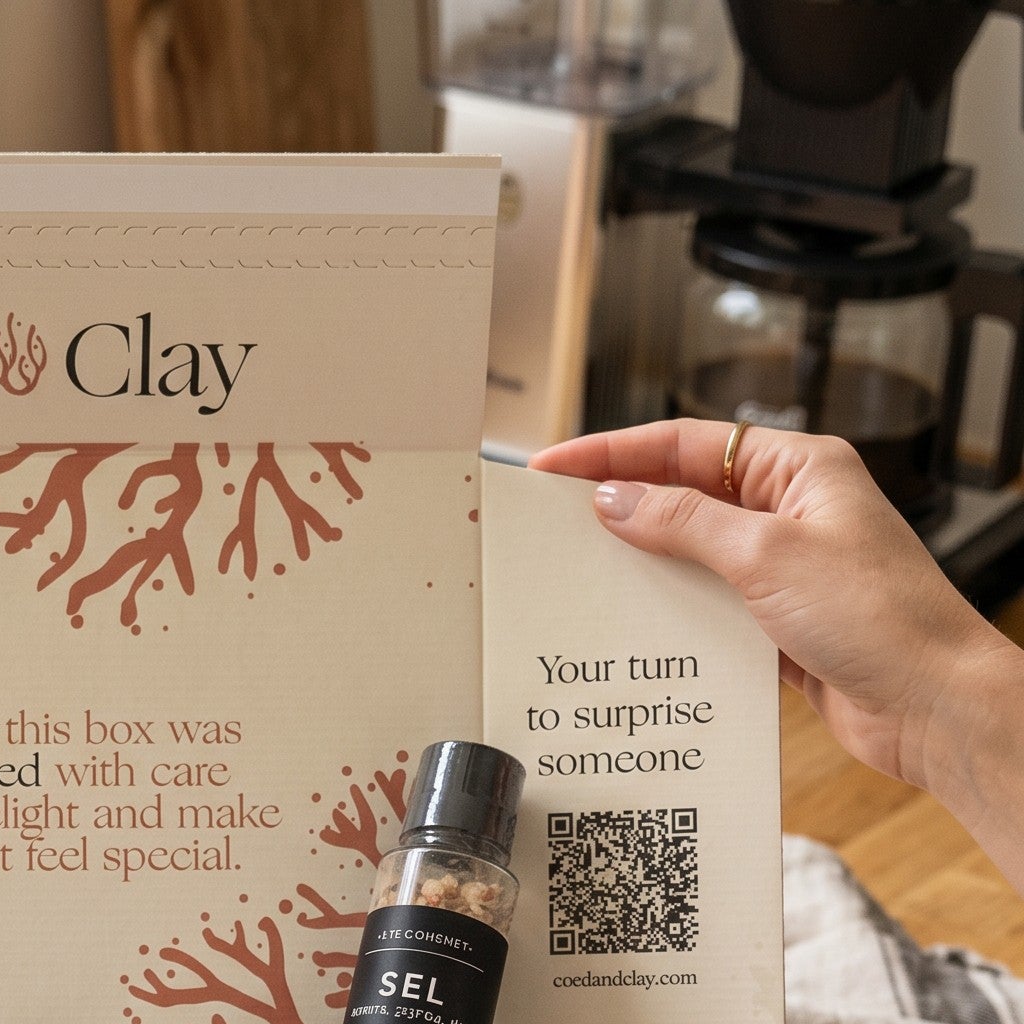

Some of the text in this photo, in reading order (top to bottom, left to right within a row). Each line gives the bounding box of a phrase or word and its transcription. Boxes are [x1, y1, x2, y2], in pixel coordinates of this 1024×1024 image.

[65, 312, 258, 415] Clay
[537, 655, 699, 684] Your turn
[5, 711, 71, 745] this
[84, 710, 155, 745] box
[168, 718, 243, 745] was
[526, 696, 715, 736] to surprise
[55, 753, 136, 787] with
[150, 760, 231, 787] care
[538, 748, 705, 776] someone
[93, 794, 163, 830] and
[176, 793, 283, 829] make
[25, 836, 88, 872] feel
[102, 836, 242, 882] special.
[378, 971, 444, 1006] SEL
[553, 971, 697, 990] coedandclay.com
